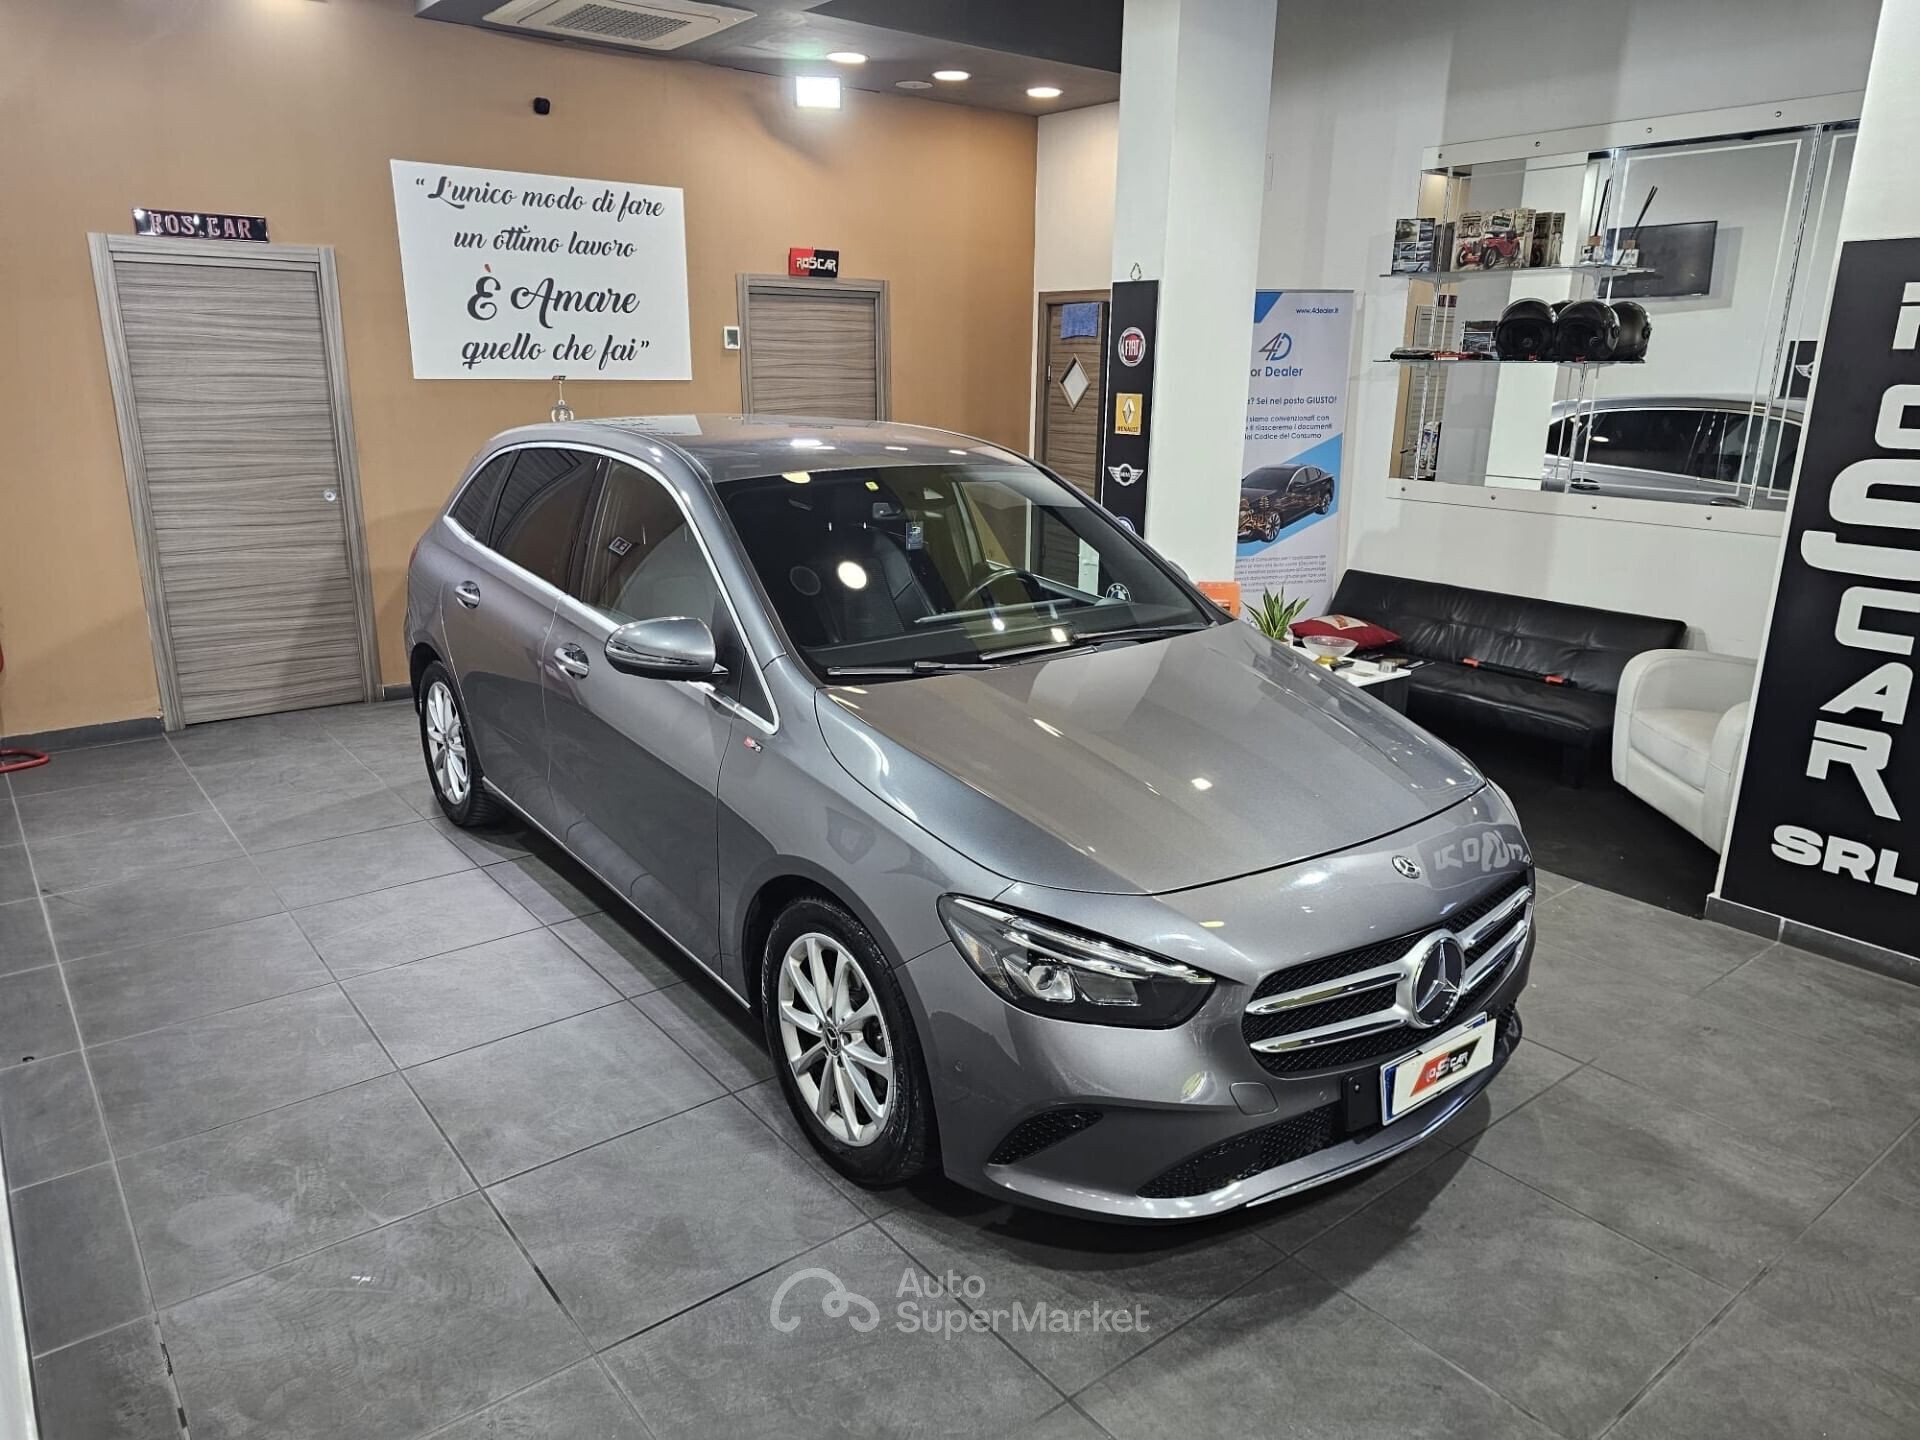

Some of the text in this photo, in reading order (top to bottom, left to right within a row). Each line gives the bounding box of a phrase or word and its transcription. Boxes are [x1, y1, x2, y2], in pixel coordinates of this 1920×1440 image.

[521, 186, 587, 212] modo
[592, 189, 616, 213] di
[616, 191, 665, 222] fare
[453, 224, 638, 258] un ottimo lavoro
[466, 263, 641, 329] È Amare
[461, 332, 546, 370] quello
[552, 334, 596, 361] che
[1124, 339, 1140, 356] FIAT
[1265, 365, 1304, 377] Dealer
[1283, 397, 1305, 406] posto
[1771, 824, 1919, 895] SRL
